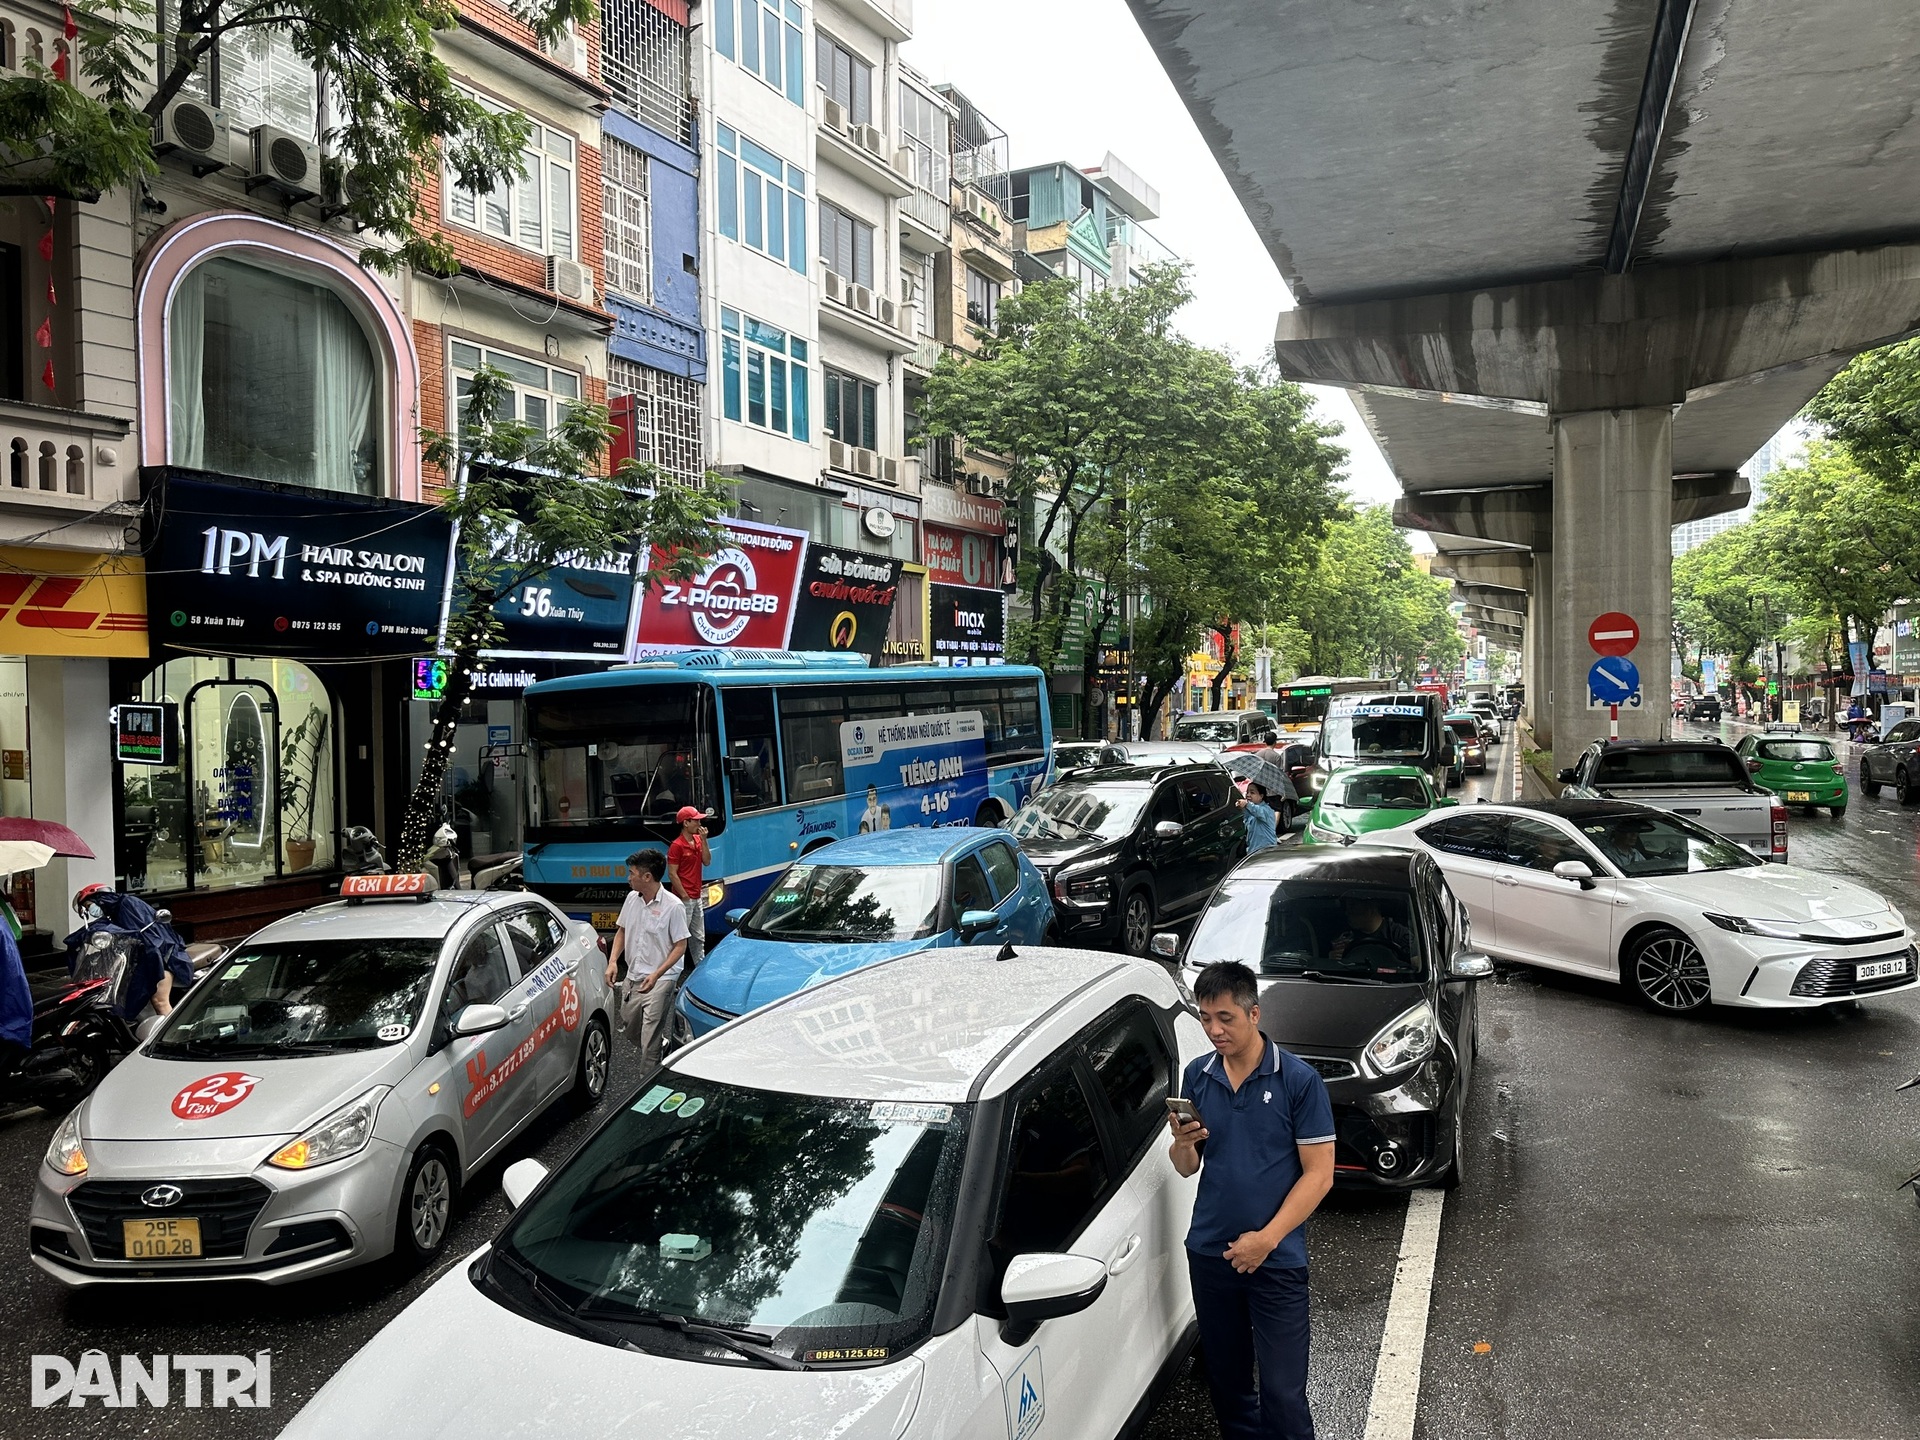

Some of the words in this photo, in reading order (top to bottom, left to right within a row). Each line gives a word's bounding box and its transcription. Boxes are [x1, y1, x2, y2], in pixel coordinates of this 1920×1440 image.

[946, 497, 975, 521] XUÂN
[737, 532, 760, 549] THOẠI
[760, 535, 770, 548] DI
[770, 535, 794, 552] ĐỘNG
[201, 526, 290, 580] 1PM
[301, 543, 354, 567] HAIR
[356, 550, 425, 574] SALON
[733, 552, 750, 573] TÍN
[819, 553, 843, 576] SỬA
[301, 569, 314, 582] &
[315, 570, 342, 584] SPA
[344, 571, 391, 588] DƯỠNG
[393, 577, 425, 591] SINH
[521, 586, 552, 617] 56
[549, 606, 566, 618] Xuân
[661, 585, 779, 613] Z-Phone88
[191, 615, 201, 625] 58
[204, 616, 224, 626] Xuân
[954, 601, 986, 628] imax
[292, 620, 310, 630] 0975
[313, 621, 326, 630] 123
[327, 622, 341, 631] 555
[381, 624, 394, 633] 1PM
[396, 625, 409, 634] Hair
[410, 626, 428, 635] Salon
[417, 660, 448, 690] 56
[488, 669, 513, 687] CHÍNH
[414, 689, 432, 698] Xuân
[126, 712, 154, 732] 1PM
[878, 726, 887, 745] HỆ
[887, 722, 906, 742] THỐNG
[907, 726, 919, 739] ANH
[864, 745, 874, 754] EDU
[899, 757, 938, 786] TIẾNG
[938, 756, 964, 780] ANH
[920, 793, 949, 815] 4-16
[798, 821, 837, 836] HANOIBUS
[590, 865, 610, 878] BUS
[348, 874, 382, 892] Taxi
[384, 874, 421, 891] 123
[574, 886, 629, 899] HANOIB
[774, 894, 798, 903] TAXI
[560, 979, 579, 1025] 123
[566, 1013, 578, 1027] Taxi
[380, 1027, 405, 1037] 221
[489, 1037, 535, 1091] 3.777.123
[179, 1075, 264, 1109] 123
[186, 1102, 220, 1114] Taxi
[145, 1221, 177, 1237] 29E
[133, 1239, 192, 1256] 010.28
[816, 1349, 886, 1359] 0984.125.625
